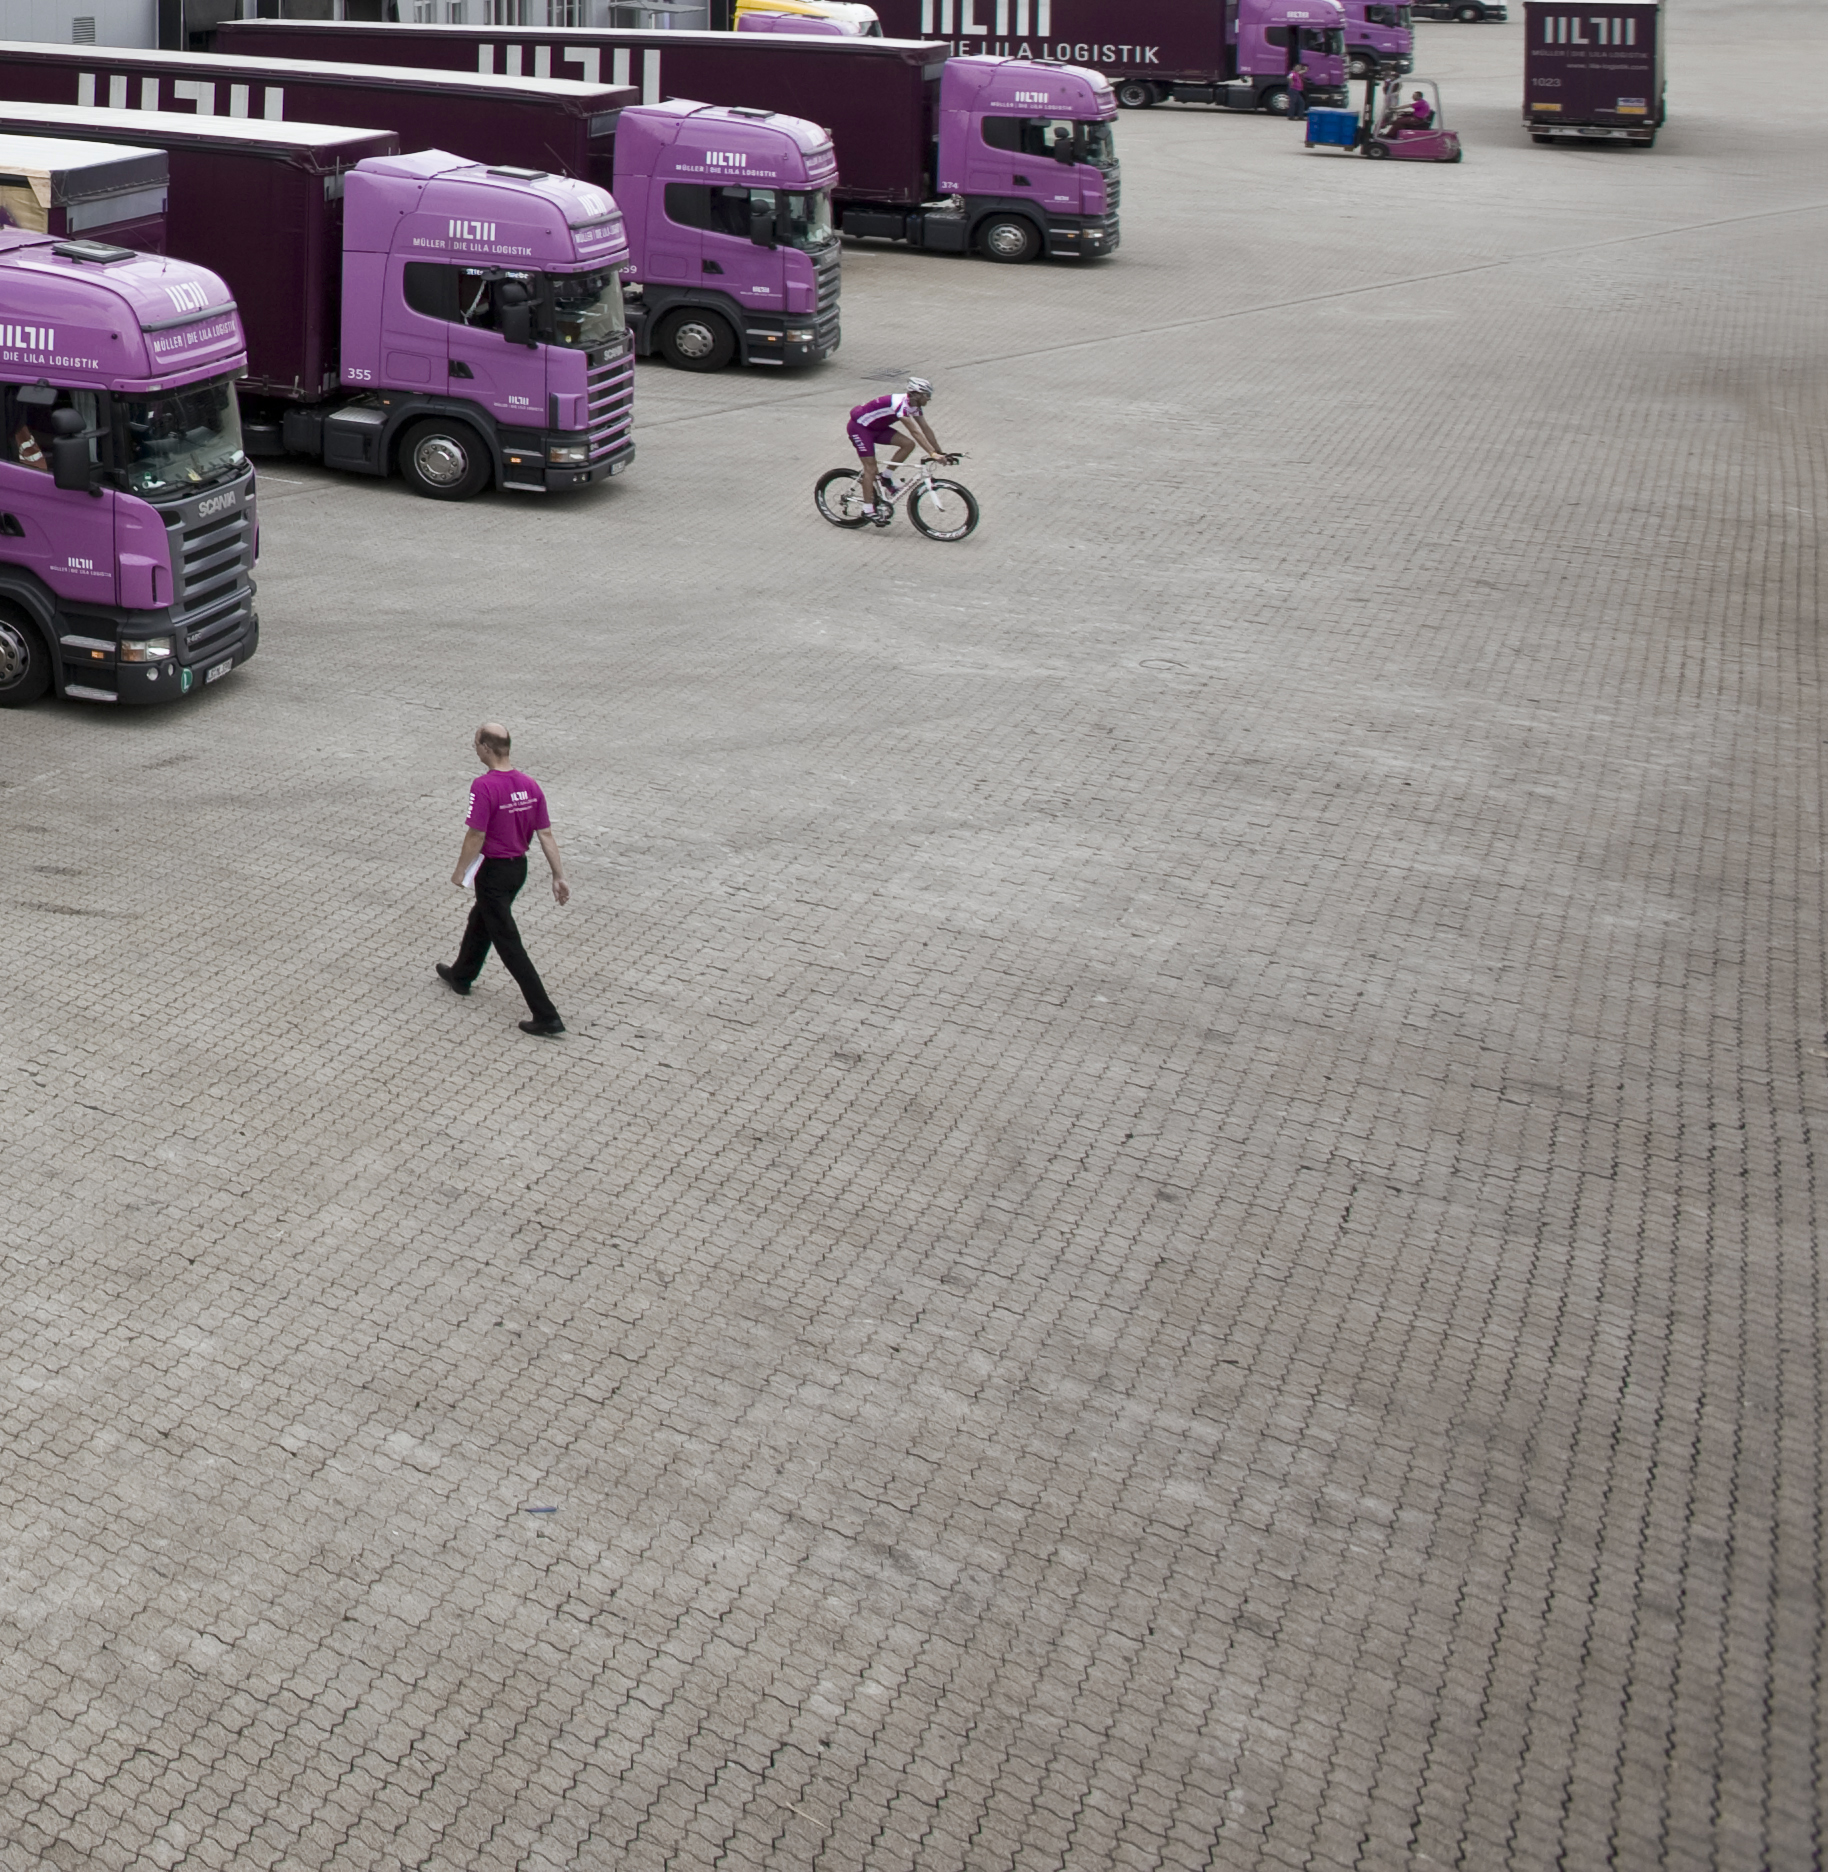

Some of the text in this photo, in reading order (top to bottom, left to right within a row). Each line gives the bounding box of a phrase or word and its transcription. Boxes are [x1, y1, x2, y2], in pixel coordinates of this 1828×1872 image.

[1043, 42, 1160, 64] LOGISTIK
[413, 237, 532, 256] MÜLLER DIE LILA LOGISTIK
[153, 334, 184, 353] MÜLLER
[212, 320, 236, 337] LOGISTIK
[3, 350, 19, 362] DIE
[24, 352, 45, 364] LILA
[49, 355, 99, 370] LOGISTIK
[347, 367, 371, 381] 355
[198, 490, 236, 518] SCANIA
